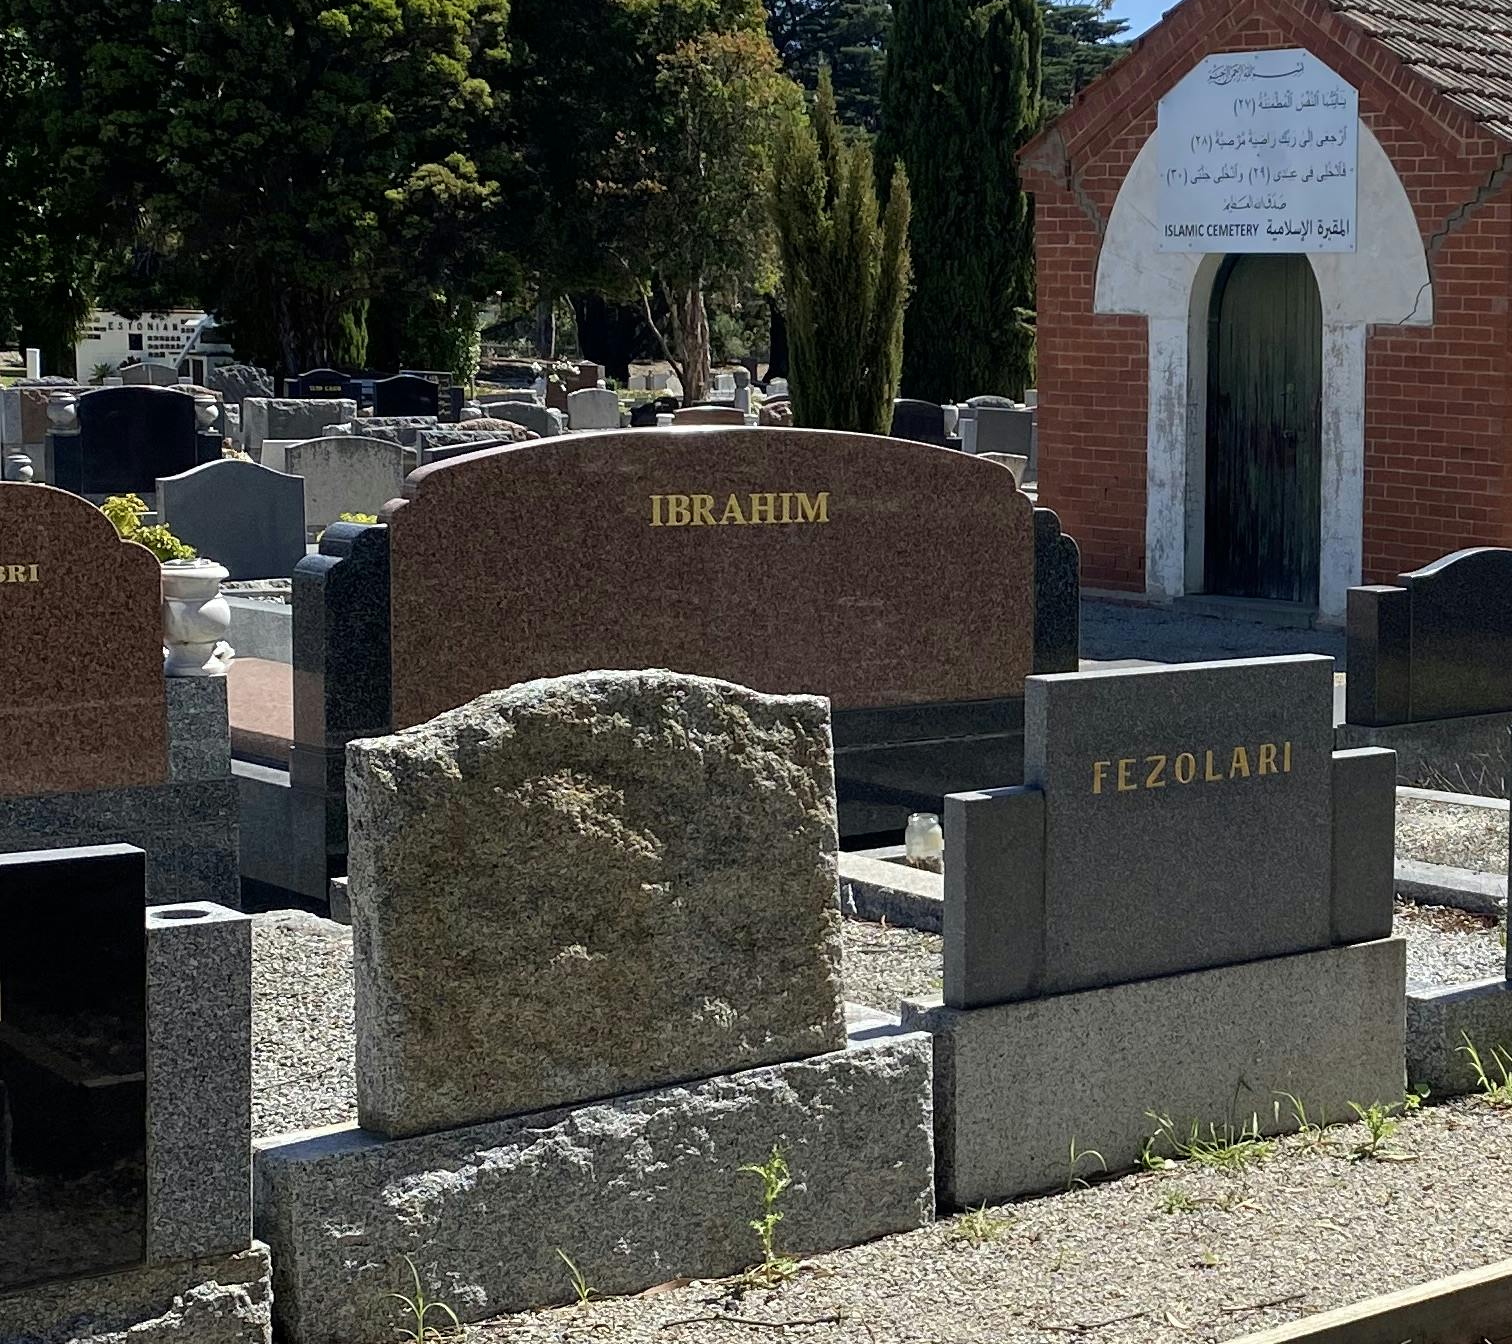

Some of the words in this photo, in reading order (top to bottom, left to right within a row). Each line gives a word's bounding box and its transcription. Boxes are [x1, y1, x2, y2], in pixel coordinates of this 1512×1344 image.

[1190, 135, 1213, 154] (٢٨)
[1166, 168, 1188, 186] (٣٠)
[1248, 167, 1271, 186] (٢٩)
[1164, 224, 1204, 237] ISLAMIC
[1206, 223, 1260, 237] CEMETERY
[1266, 218, 1313, 242] الإسلامية
[1317, 218, 1350, 241] المقبرة
[108, 321, 178, 331] ESTONIAN
[648, 492, 830, 526] IBRAHIM
[1092, 740, 1293, 795] FEZOLARI
